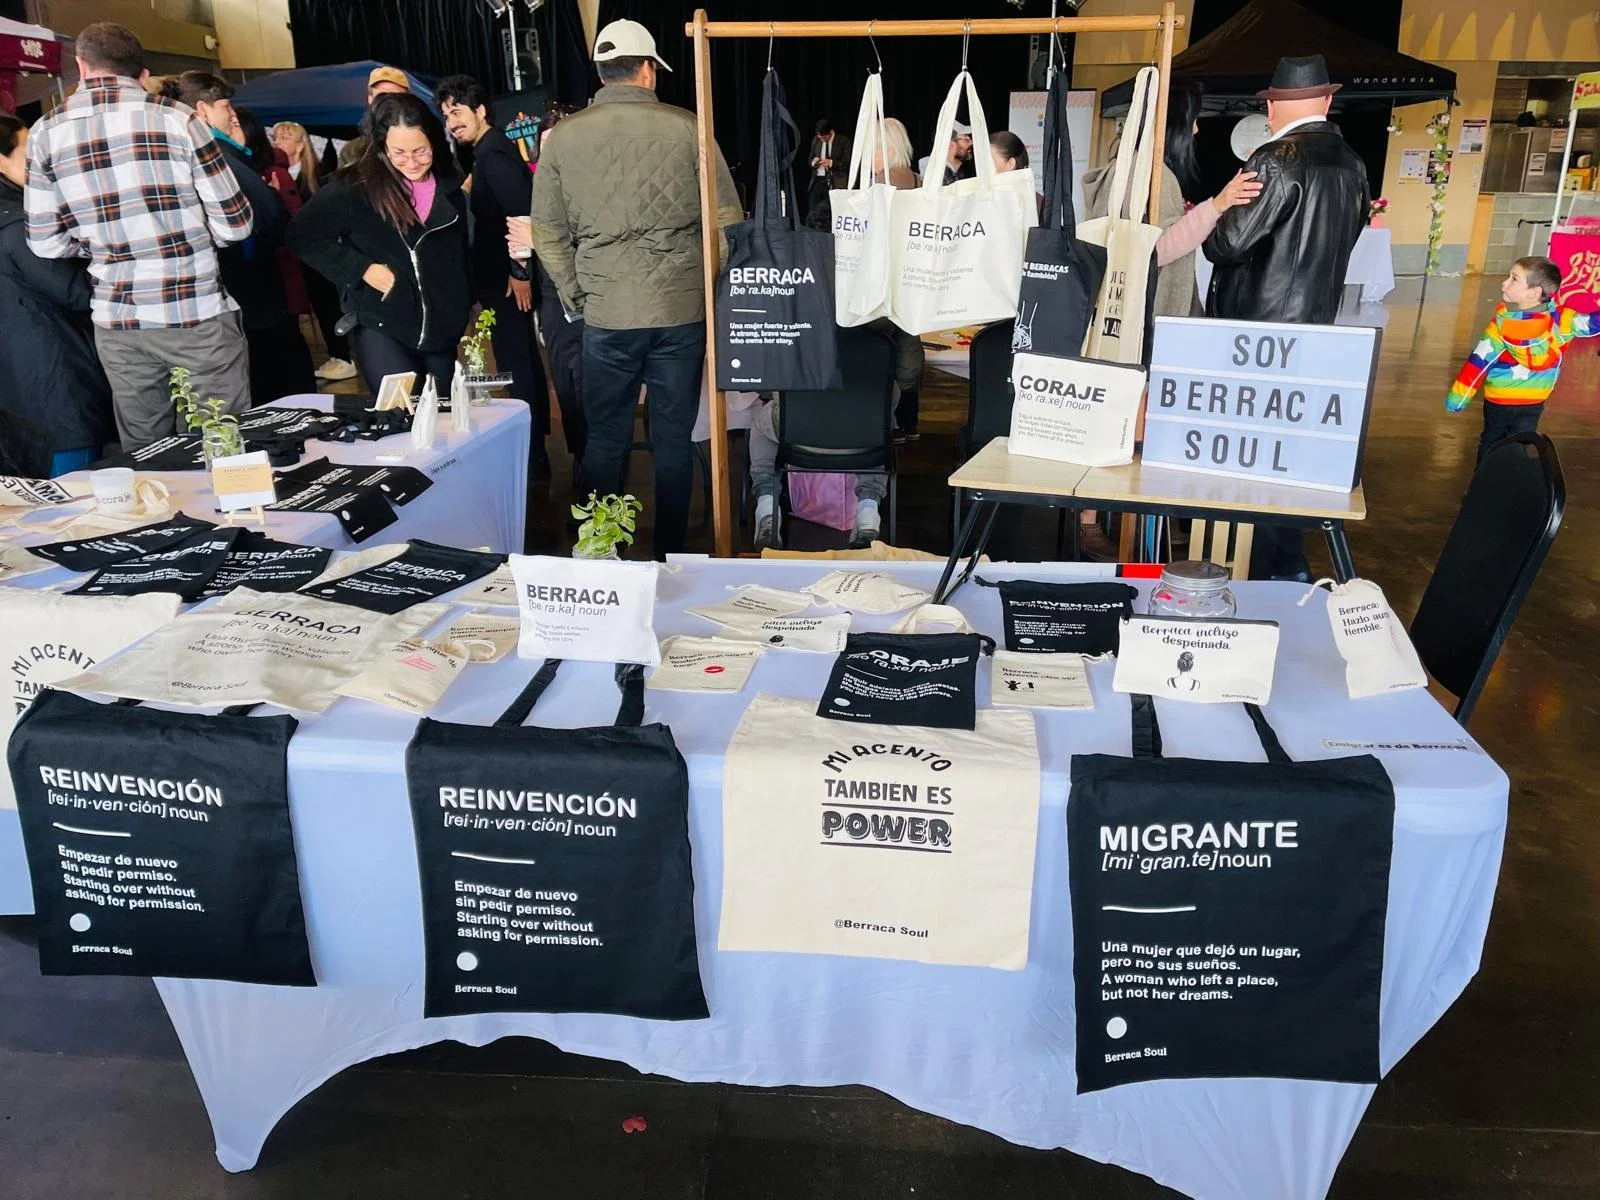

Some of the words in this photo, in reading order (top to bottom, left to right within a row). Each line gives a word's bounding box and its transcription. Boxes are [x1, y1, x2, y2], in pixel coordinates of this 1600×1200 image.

[729, 267, 815, 285] BERRACA
[1029, 262, 1070, 274] BERRACAS
[1232, 334, 1298, 369] SOY
[1020, 374, 1107, 403] CORAJE
[1184, 429, 1289, 472] SOUL
[386, 560, 467, 581] BERRACA
[526, 583, 620, 606] BERRACA
[1338, 601, 1380, 616] Berraca:
[1342, 614, 1370, 627] Hazlo
[1142, 625, 1192, 635] Berraca
[1196, 625, 1239, 640] incluso
[1162, 635, 1231, 650] despeinada.
[11, 655, 32, 677] MI
[30, 643, 96, 670] ACENT
[821, 750, 853, 773] MI
[852, 743, 952, 772] ACENTO
[39, 765, 224, 807] REINVENCIÓN
[927, 786, 952, 806] ES
[439, 786, 637, 818] REINVENCIÓN
[169, 806, 209, 822] noun
[573, 823, 617, 837] noun
[822, 810, 952, 847] POWER
[1099, 821, 1299, 852] MIGRANTE
[57, 844, 111, 866] Empezar
[114, 854, 132, 866] de
[135, 856, 178, 869] nuevo
[60, 860, 79, 873] sin
[81, 863, 114, 878] pedir
[117, 870, 177, 883] permiso.
[63, 873, 110, 894] Starting
[112, 885, 143, 895] over
[145, 885, 196, 898] without
[454, 880, 512, 897] Empezar
[514, 888, 532, 900] de
[535, 890, 578, 902] nuevo
[65, 888, 105, 906] asking
[106, 894, 126, 907] for
[128, 899, 206, 913] permission.
[455, 896, 476, 908] sin
[479, 899, 513, 913] pedir
[516, 903, 576, 917] permiso.
[456, 911, 508, 928] Starting
[510, 919, 540, 930] over
[542, 919, 594, 933] without
[834, 919, 896, 934] @Berraca
[900, 926, 929, 939] Soul
[457, 926, 501, 942] asking
[503, 929, 522, 942] for
[525, 933, 603, 947] permission.
[71, 944, 110, 954] Berraca
[111, 945, 133, 956] Soul
[1101, 941, 1128, 954] Una
[1131, 942, 1173, 957] mujer
[1176, 945, 1201, 958] que
[1204, 943, 1236, 958] dejó
[1239, 945, 1257, 957] un
[1262, 945, 1301, 959] lugar,
[1101, 957, 1132, 971] pero
[1135, 959, 1154, 970] no
[1157, 960, 1183, 971] sus
[1186, 958, 1241, 971] sueños.
[454, 984, 493, 994] Berraca
[495, 985, 517, 995] Soul
[1101, 973, 1112, 986] A
[1114, 974, 1163, 986] woman
[1167, 975, 1197, 987] who
[1200, 974, 1222, 986] left
[1225, 976, 1234, 986] a
[1237, 975, 1279, 988] place,
[1102, 989, 1123, 1001] but
[1125, 987, 1149, 999] not
[1152, 988, 1175, 1000] her
[1178, 989, 1233, 1001] dreams.
[1104, 1050, 1142, 1064] Berraca
[1143, 1047, 1168, 1057] Soul
